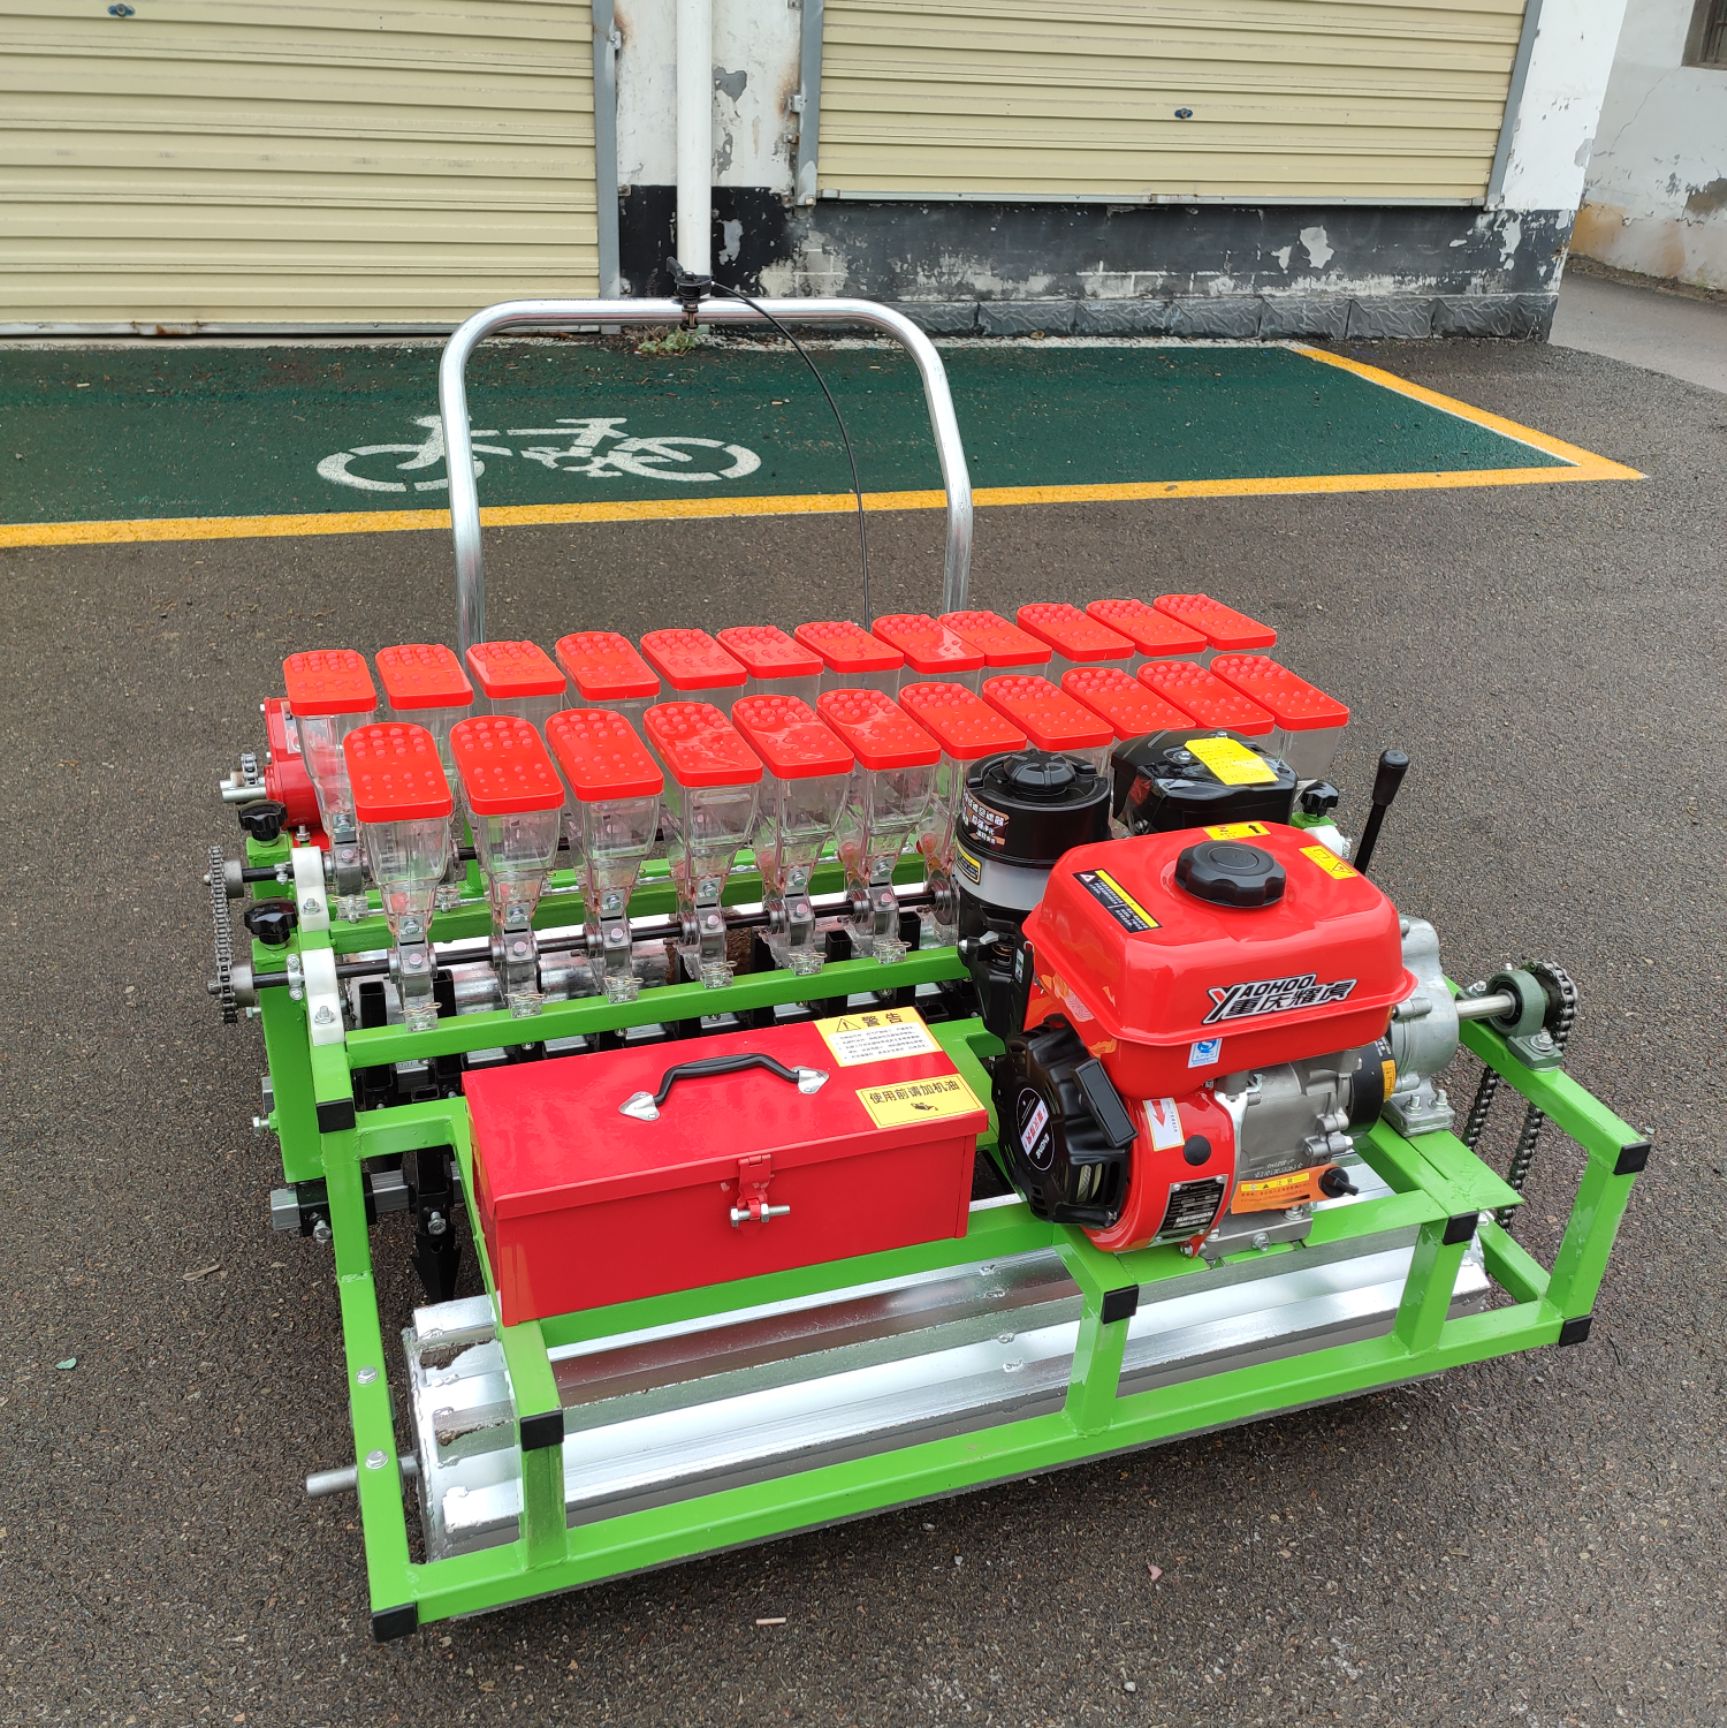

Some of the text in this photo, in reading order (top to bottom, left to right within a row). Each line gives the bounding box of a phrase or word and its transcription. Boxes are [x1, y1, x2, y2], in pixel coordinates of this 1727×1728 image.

[1203, 973, 1316, 1025] YAOHOO
[861, 1012, 903, 1027] 警告
[869, 1080, 960, 1104] 使用前请加机油
